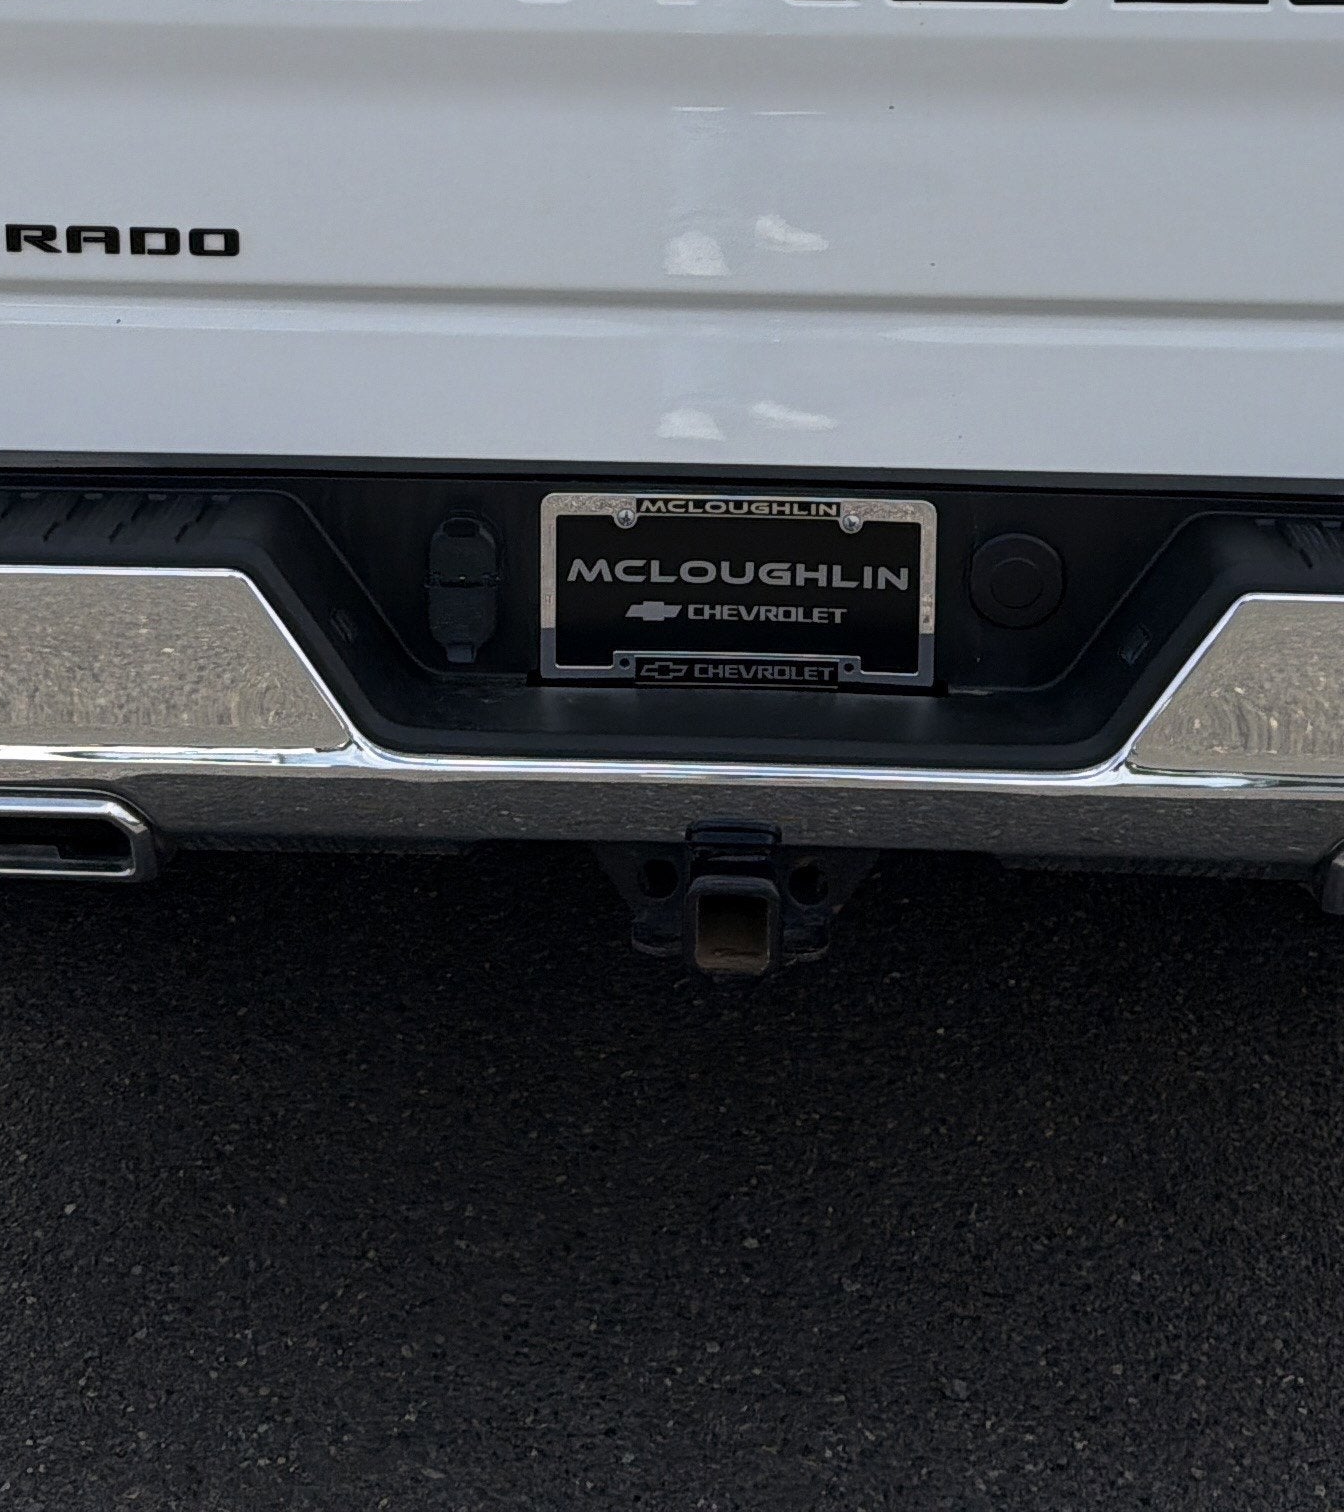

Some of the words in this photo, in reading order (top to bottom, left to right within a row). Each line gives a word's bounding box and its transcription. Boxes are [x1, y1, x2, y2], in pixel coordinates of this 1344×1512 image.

[639, 499, 838, 517] MCLOUGHLIN
[566, 558, 909, 591] MCLOUGHLIN
[687, 603, 849, 624] CHEVROLET
[693, 663, 835, 682] CHEVROLET
